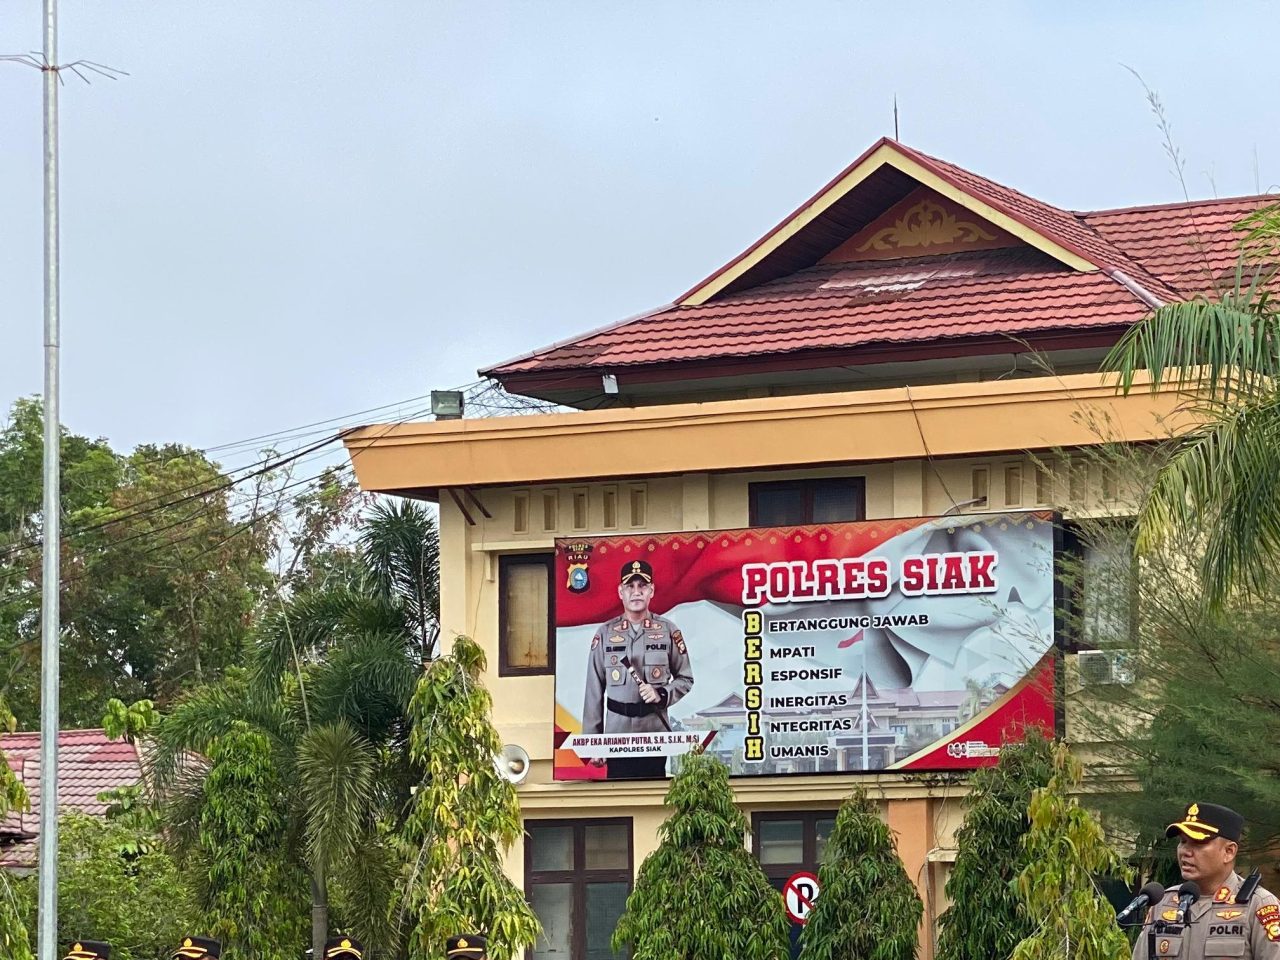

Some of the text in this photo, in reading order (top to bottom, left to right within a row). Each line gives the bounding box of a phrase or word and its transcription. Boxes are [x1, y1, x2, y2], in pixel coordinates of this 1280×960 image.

[744, 553, 996, 601] POLRES SIAK
[873, 613, 929, 627] JAWAB
[572, 738, 589, 746] AKBP
[590, 737, 602, 746] EKA
[603, 737, 630, 746] ARIANDY
[797, 883, 814, 914] P
[1209, 925, 1243, 935] POLRI
